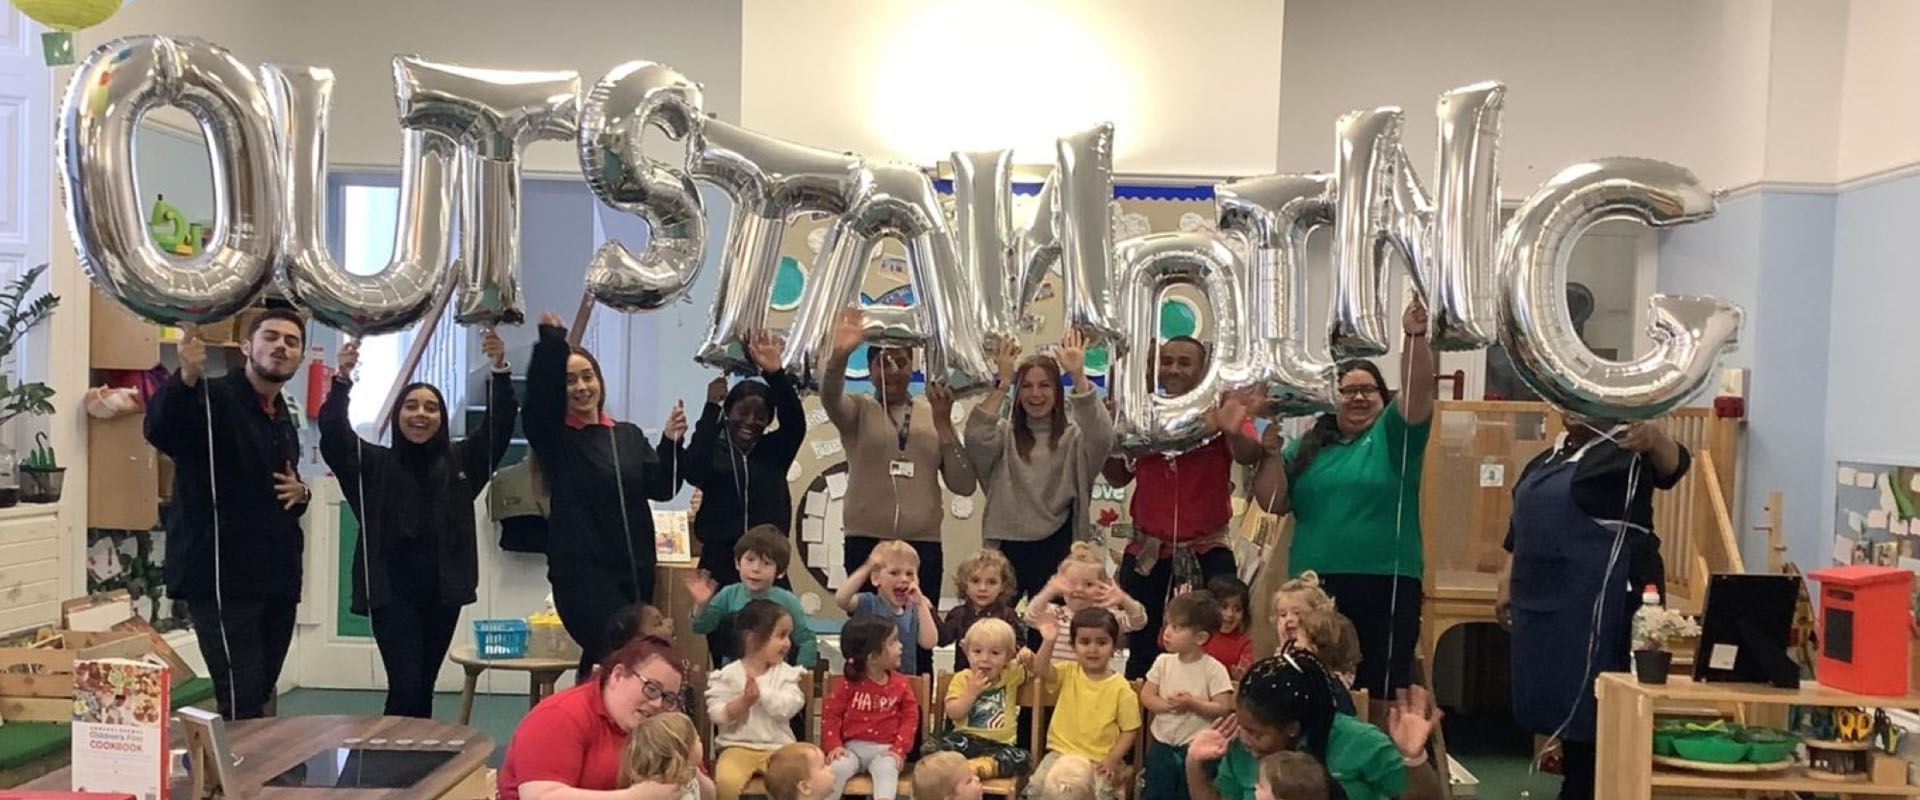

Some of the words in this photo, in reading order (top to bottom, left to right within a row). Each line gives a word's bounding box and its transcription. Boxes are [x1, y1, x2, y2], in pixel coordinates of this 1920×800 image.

[56, 34, 1744, 454] OUTSTANDING
[1091, 483, 1125, 503] ove
[89, 740, 144, 752] COOKBOOK
